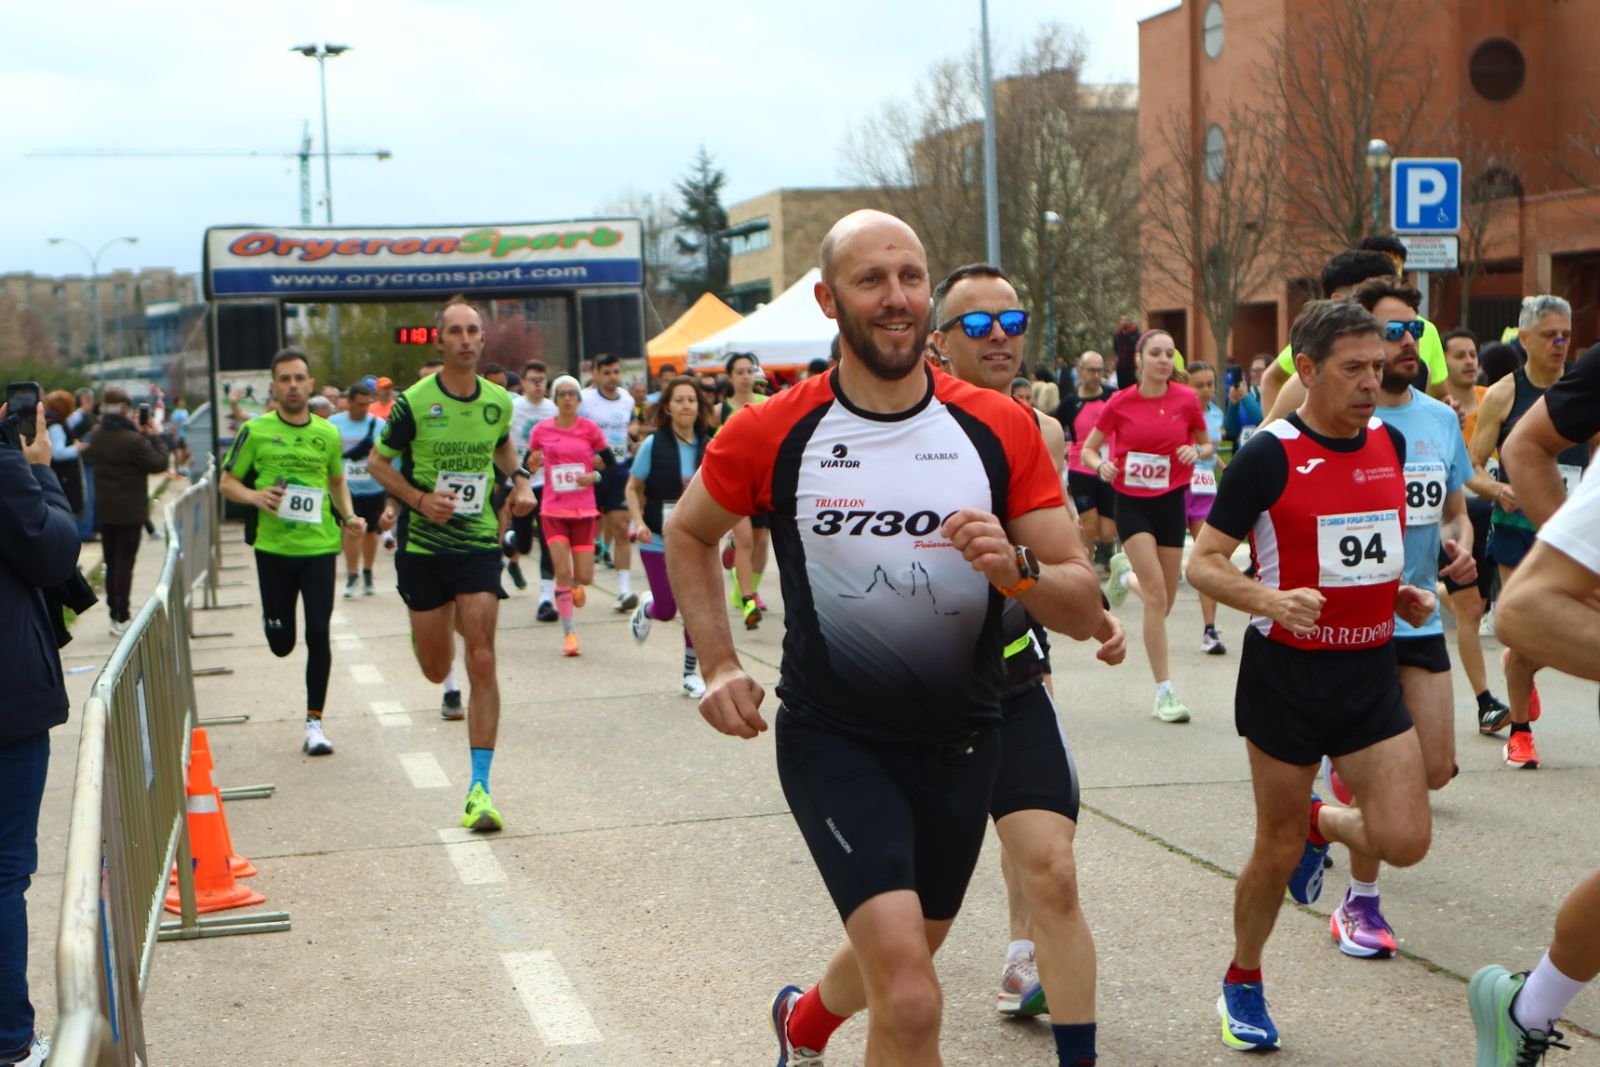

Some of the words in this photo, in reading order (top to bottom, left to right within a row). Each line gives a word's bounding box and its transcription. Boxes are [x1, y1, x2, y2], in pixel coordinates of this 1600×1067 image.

[1407, 168, 1448, 224] P
[271, 266, 587, 286] www.orycronsport.com
[820, 459, 861, 469] VIATOR
[915, 452, 959, 461] CARABIAS
[1129, 463, 1168, 479] 202
[448, 483, 476, 502] 79
[1406, 480, 1443, 508] 89
[290, 495, 314, 513] 80
[815, 498, 866, 508] TRIATLON
[1339, 532, 1387, 568] 94
